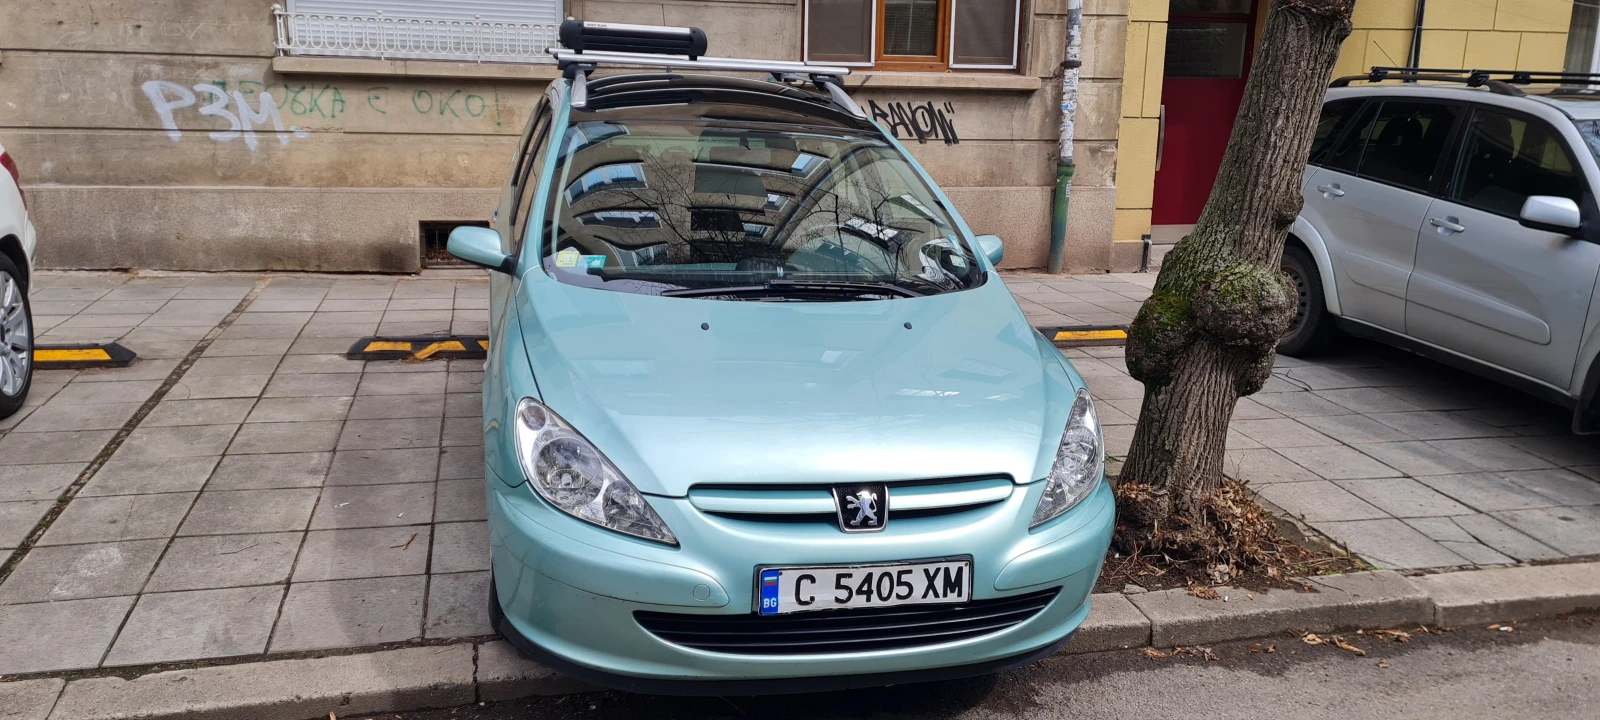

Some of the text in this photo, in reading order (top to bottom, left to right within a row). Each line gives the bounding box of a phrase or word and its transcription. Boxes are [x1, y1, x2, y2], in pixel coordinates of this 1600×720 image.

[794, 565, 964, 606] C 5405 XM
[763, 598, 777, 609] BG
